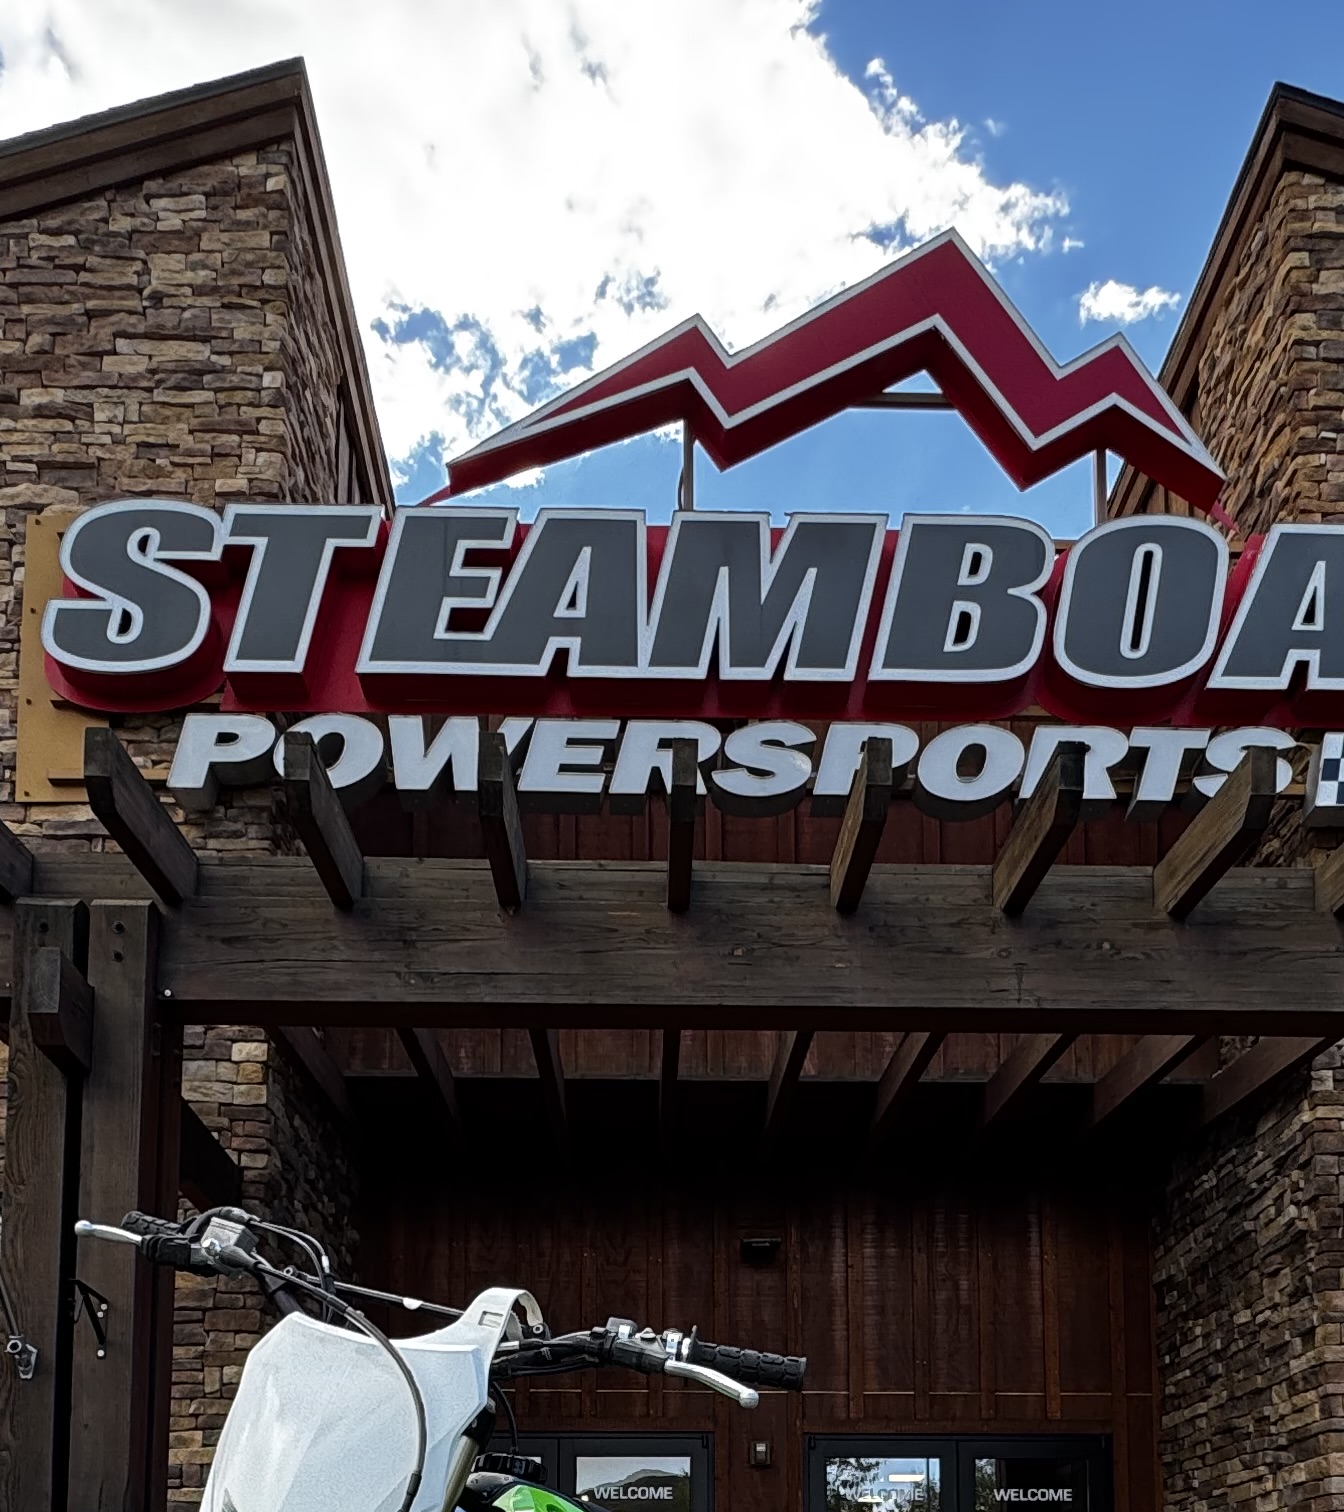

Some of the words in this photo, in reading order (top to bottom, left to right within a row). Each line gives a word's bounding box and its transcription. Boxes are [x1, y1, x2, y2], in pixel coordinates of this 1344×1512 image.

[166, 712, 1297, 802] POWERSPORTS
[594, 1486, 673, 1500] WELCOME
[994, 1488, 1073, 1502] WELCOME
